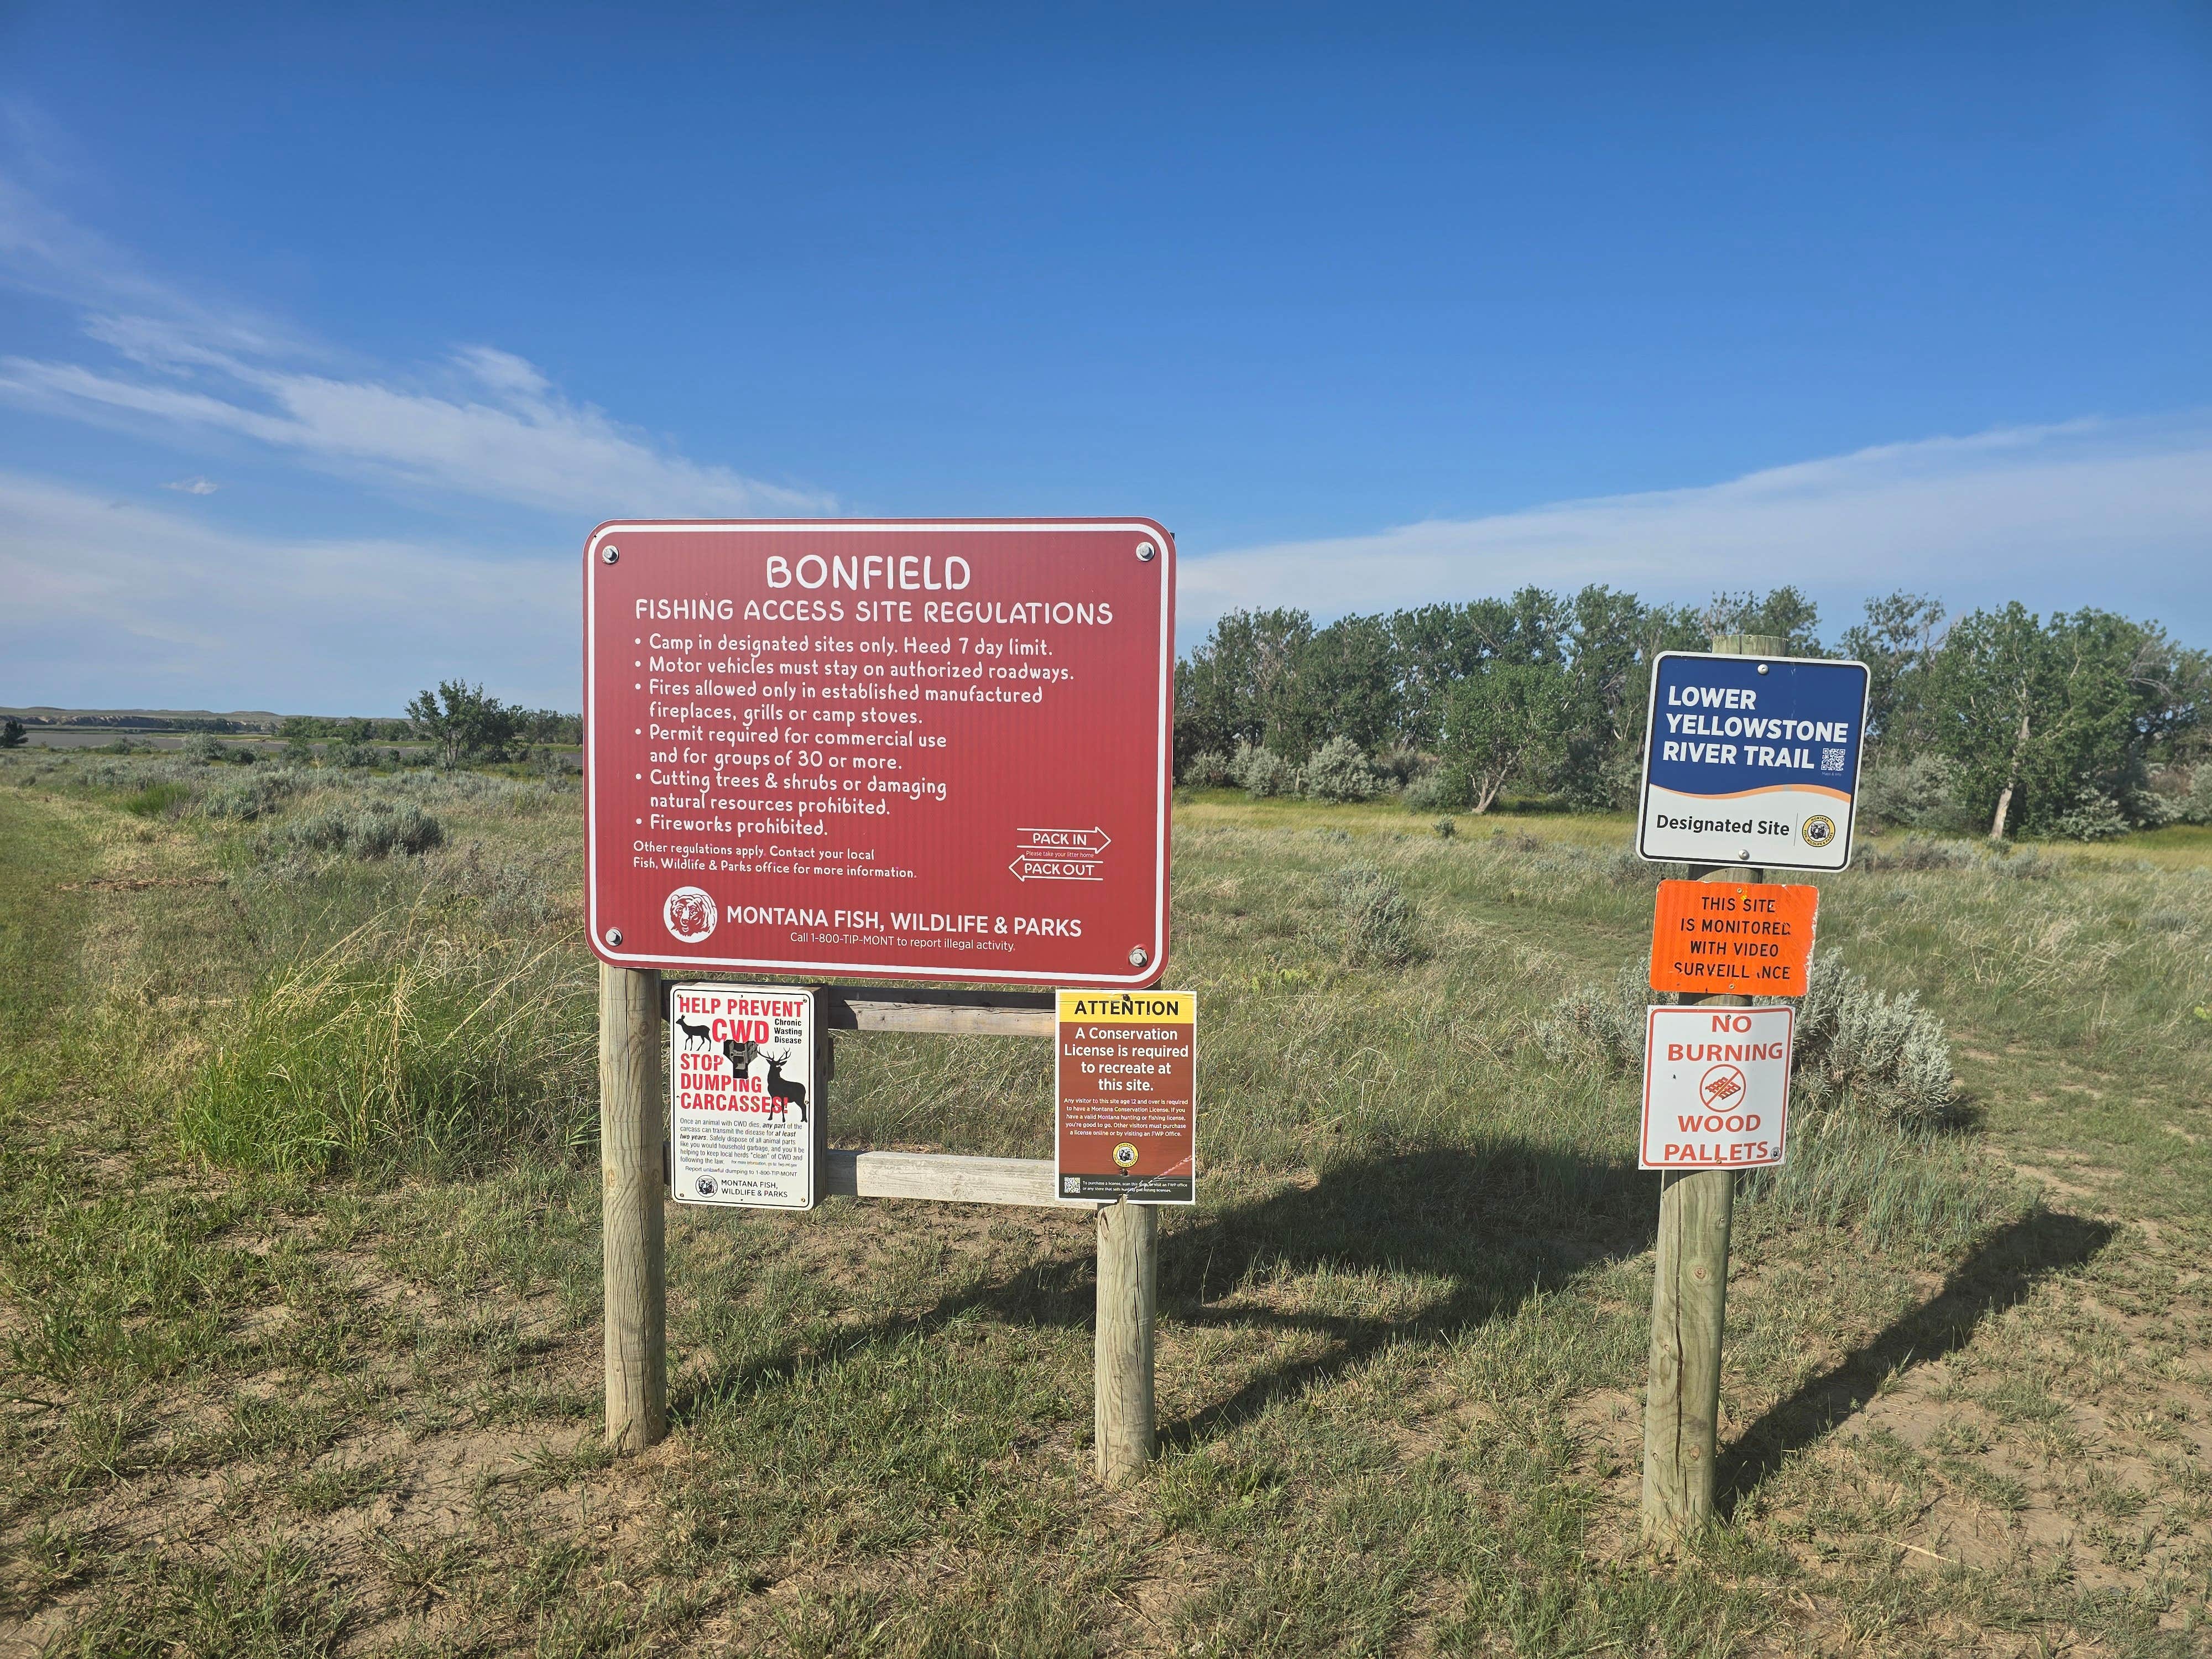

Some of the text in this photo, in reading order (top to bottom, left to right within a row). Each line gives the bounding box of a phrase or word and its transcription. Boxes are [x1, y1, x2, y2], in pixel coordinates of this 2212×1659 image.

[767, 555, 970, 591] BONFIELD
[637, 599, 1112, 625] FISHING ACCESS SITE REGULATIONS
[650, 633, 1052, 658] Camp in designated sites only. Heed 7 day limit.
[650, 656, 1073, 683] Motor vehicles must stay on authorized roadways.
[650, 679, 1042, 703] Fires allowed only in established manufactured
[1668, 686, 1756, 709] LOWER
[650, 701, 922, 727] fireplaces, grills or camp stoves.
[650, 724, 946, 747] Permit required for commercial use
[1666, 713, 1848, 743] YELLOWSTONE
[650, 747, 901, 771] and for groups of 30 or more.
[1663, 741, 1814, 769] RIVER TRAIL
[650, 769, 946, 801] Cutting trees & shrubs or damaging
[650, 792, 889, 817] natural resources prohibited.
[651, 814, 827, 837] Fireworks prohibited.
[1657, 815, 1789, 836] Designated Site
[1033, 833, 1086, 845] PACK IN
[634, 841, 667, 852] Other
[671, 843, 732, 858] regulations
[770, 846, 815, 858] Contact
[819, 851, 843, 860] your
[848, 848, 874, 860] local
[634, 857, 658, 869] Fish,
[661, 858, 705, 870] Wildlife
[709, 860, 717, 870] &
[721, 860, 752, 872] Parks
[755, 862, 789, 873] office
[794, 863, 810, 874] for
[847, 865, 916, 878] information.
[1025, 863, 1094, 875] PACK OUT
[1702, 897, 1775, 912] THIS SITE
[728, 906, 1081, 937] MONTANA FISH, WILDLIFE & PARKS
[1681, 918, 1791, 935] IS MONITORED
[791, 932, 1015, 952] Call 1-800-TIP-MONT to report illegal activity.
[1691, 941, 1778, 957] WITH VIDEO
[1674, 962, 1790, 979] SURVEILLNCE
[680, 998, 803, 1017] HELP PREVENT
[1074, 1000, 1178, 1015] ATTENTION
[712, 1019, 769, 1044] CWD
[774, 1027, 802, 1036] Wasting
[1076, 1027, 1177, 1040] A Conservation
[1712, 1015, 1751, 1033] NO
[1065, 1044, 1188, 1059] License is required
[1668, 1042, 1782, 1061] BURNING
[681, 1053, 723, 1071] STOP
[1081, 1062, 1171, 1074] to recreate at
[681, 1073, 761, 1093] DUMPING
[1098, 1078, 1153, 1091] this site.
[681, 1092, 789, 1113] CARCASSES!
[1678, 1115, 1761, 1133] WOOD
[1665, 1141, 1767, 1161] PALLETS
